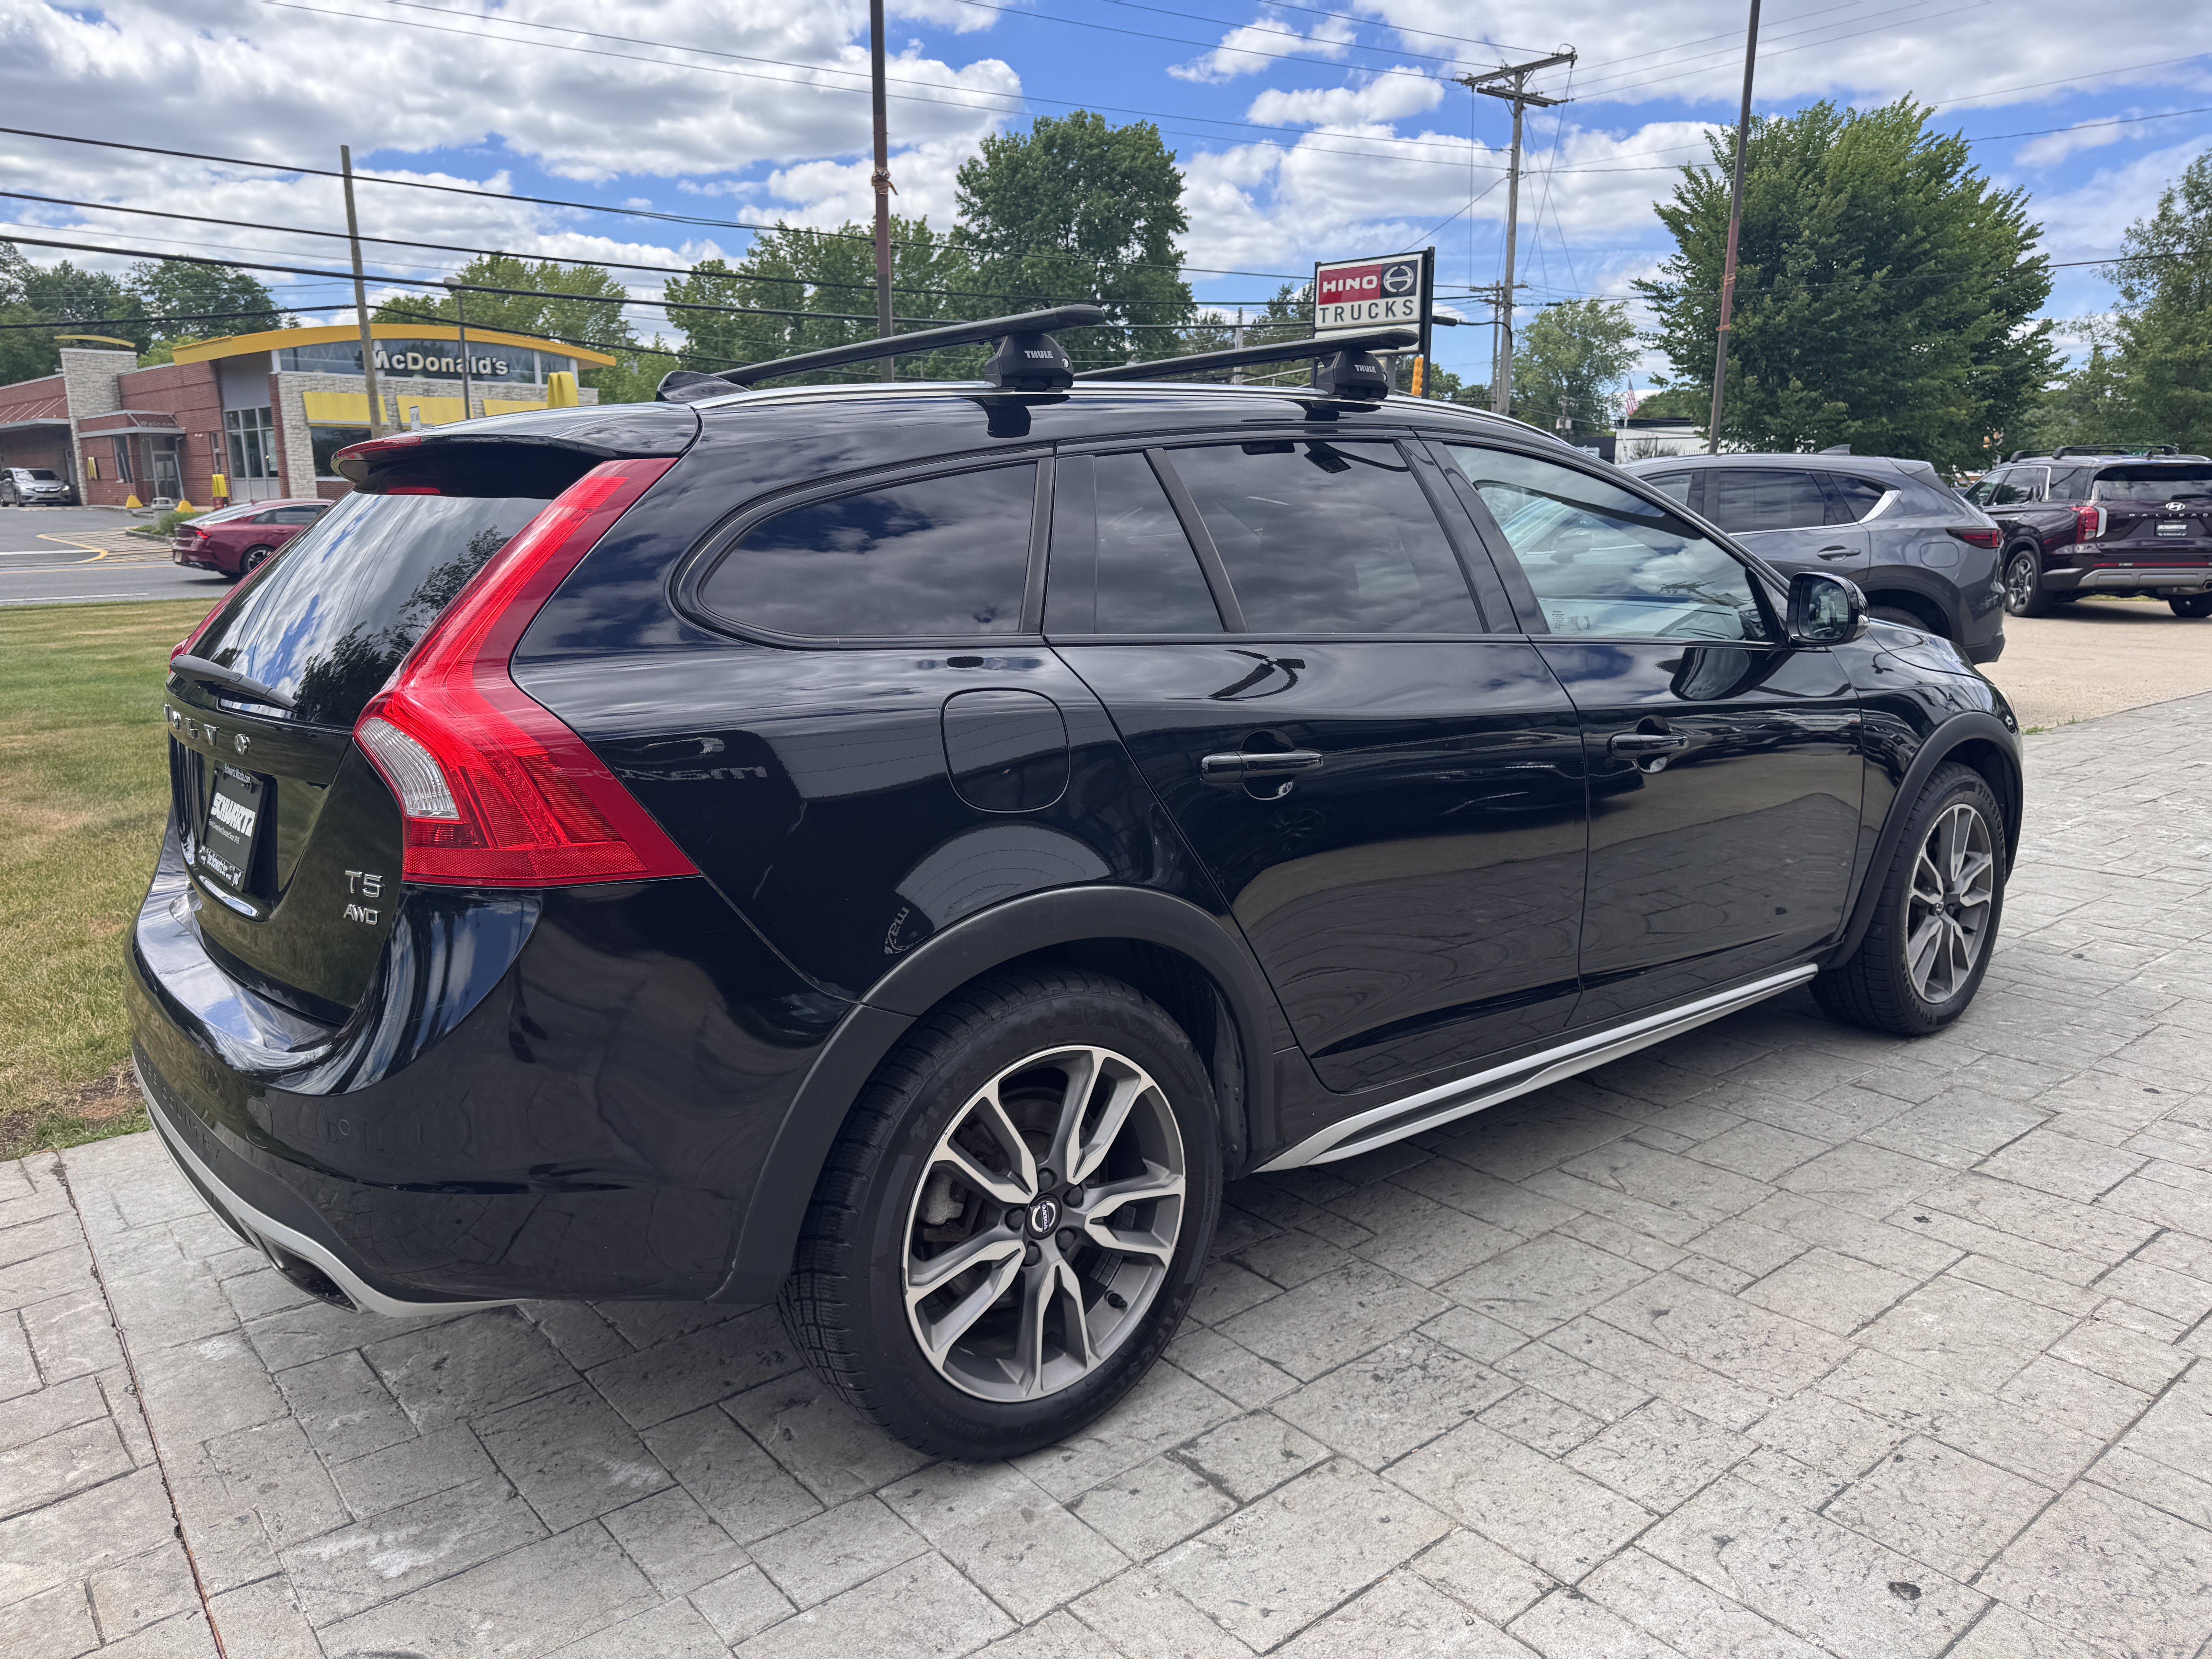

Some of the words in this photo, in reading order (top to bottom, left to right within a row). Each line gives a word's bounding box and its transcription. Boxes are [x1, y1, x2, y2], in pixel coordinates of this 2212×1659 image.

[1322, 275, 1377, 293] HINO
[1319, 299, 1414, 324] TRUCKS
[373, 350, 508, 376] McDonald's
[1024, 350, 1053, 359] THULE
[1354, 364, 1376, 373] THULE
[210, 792, 256, 837] SCHWARTZ
[1978, 784, 2005, 852] Firestone
[345, 870, 383, 898] T5
[343, 904, 379, 925] AWD
[1901, 961, 1933, 1025] Firestone
[162, 1085, 220, 1158] COUNTRY
